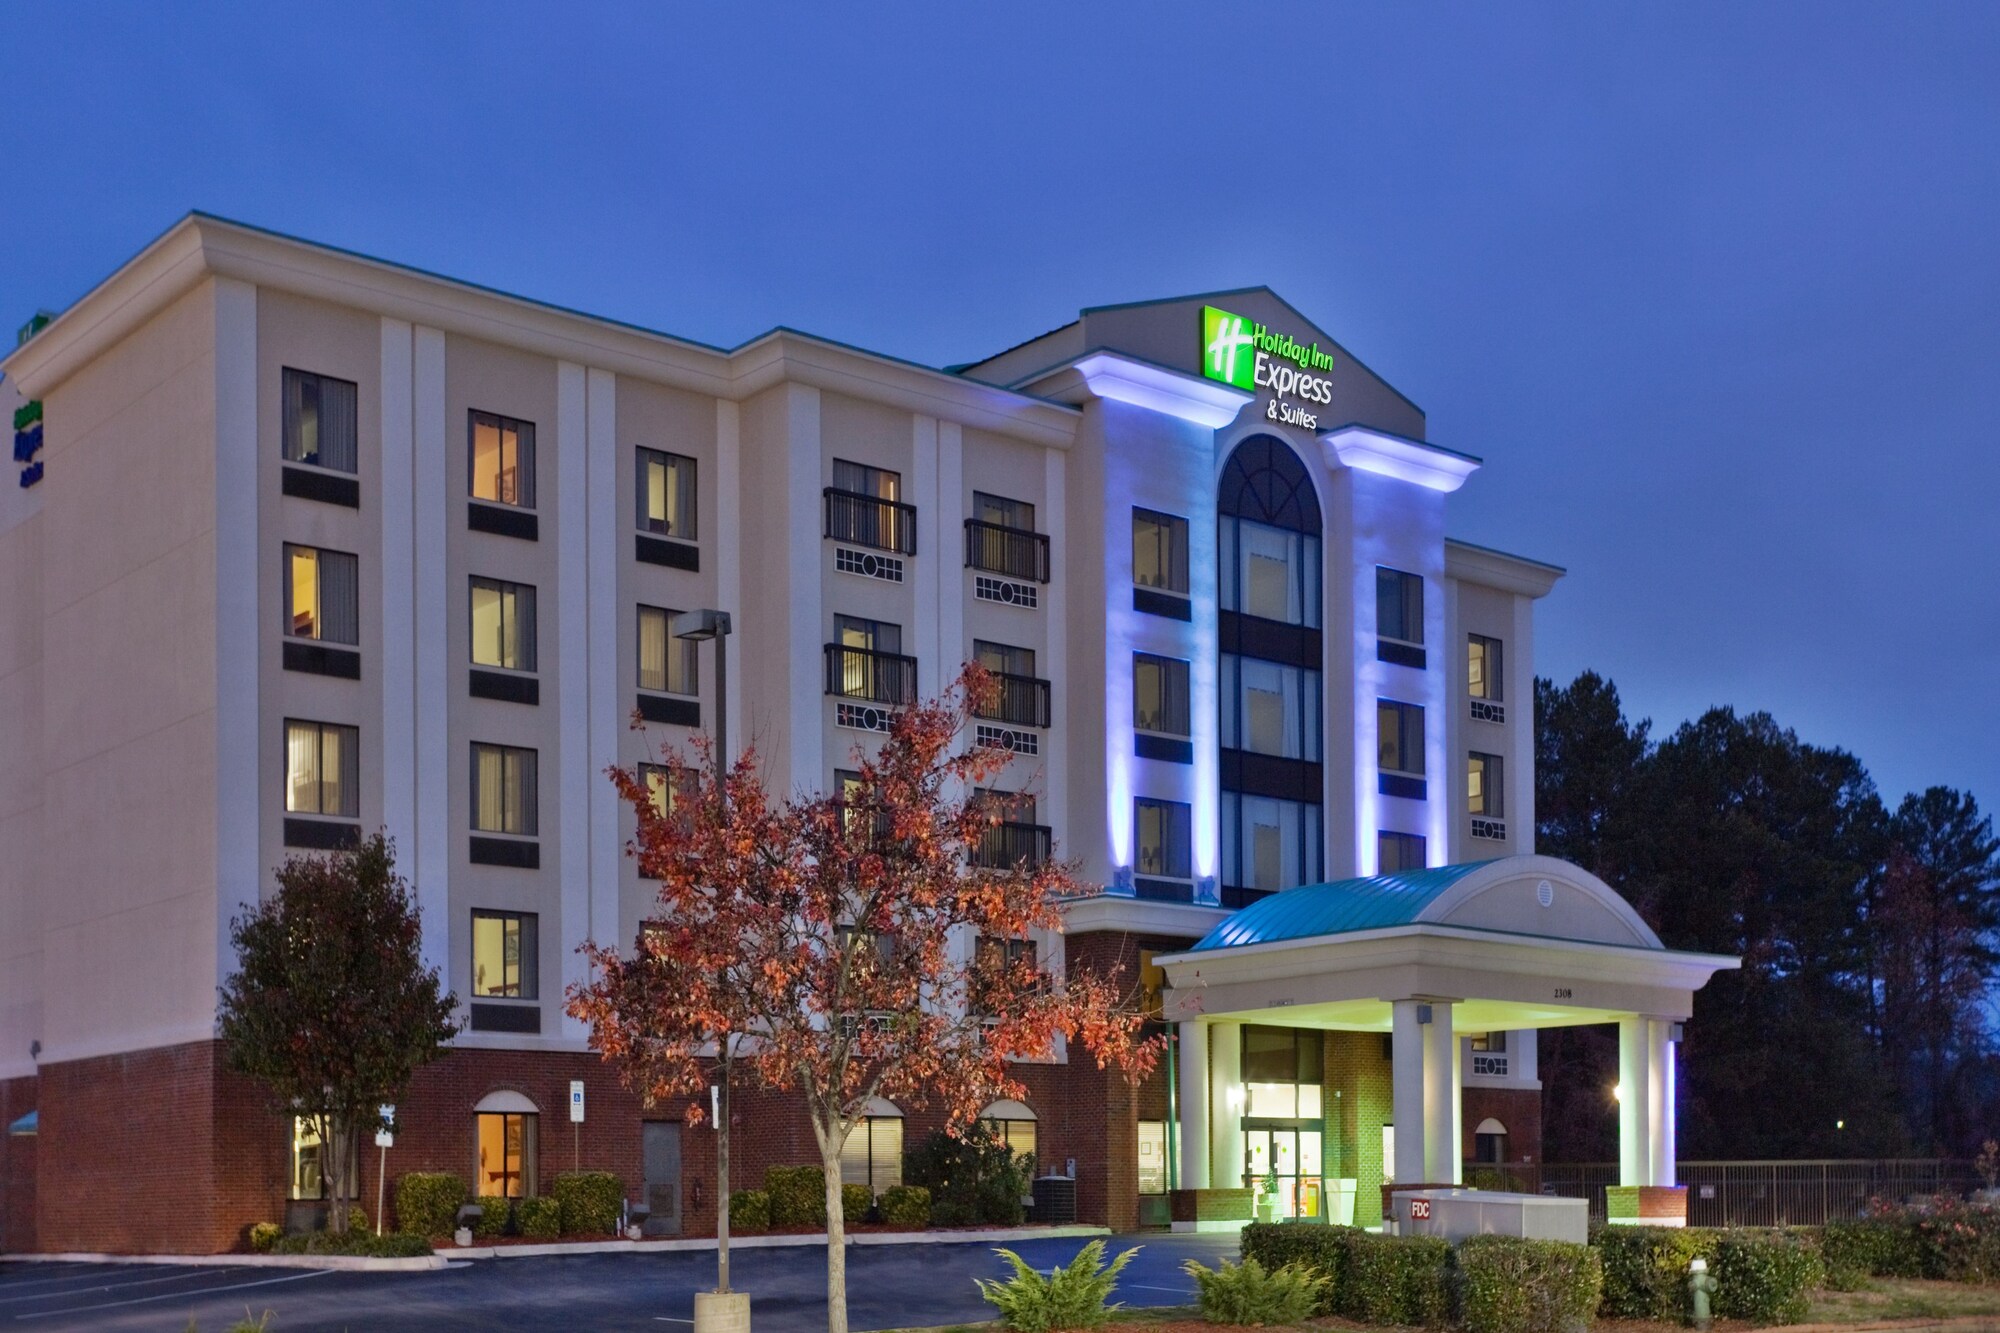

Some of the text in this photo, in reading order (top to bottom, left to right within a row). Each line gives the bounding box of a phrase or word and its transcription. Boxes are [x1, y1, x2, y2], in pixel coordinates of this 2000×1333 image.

[1208, 317, 1254, 383] H
[1253, 323, 1334, 372] Holiday Inn
[1253, 351, 1333, 404] Express
[1267, 399, 1317, 430] & Suites
[1554, 988, 1572, 998] 2308
[1412, 1201, 1430, 1217] FDC
